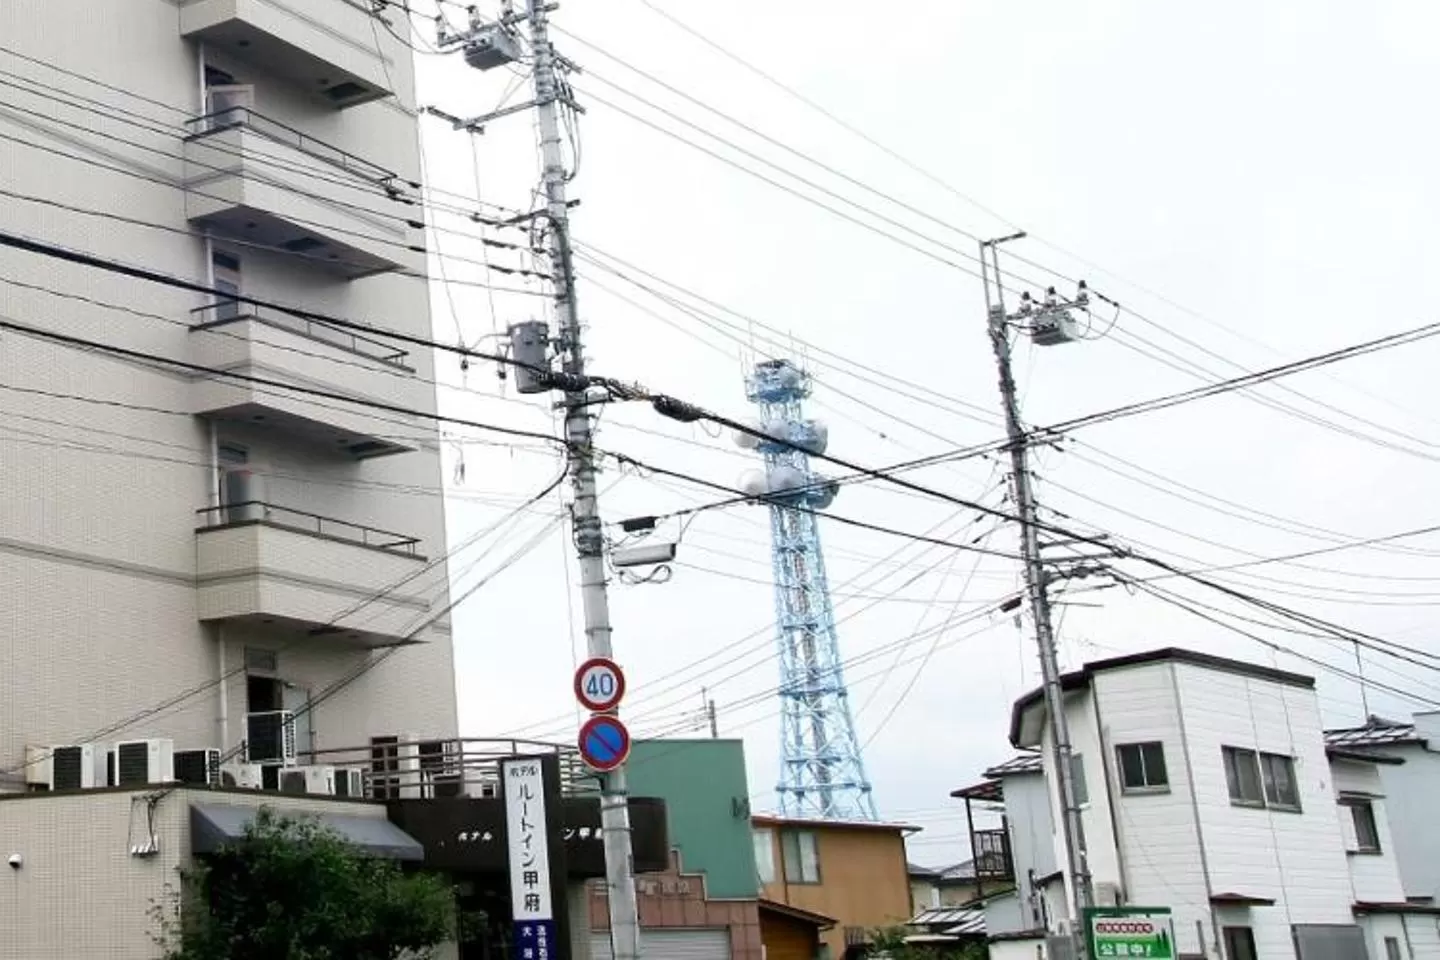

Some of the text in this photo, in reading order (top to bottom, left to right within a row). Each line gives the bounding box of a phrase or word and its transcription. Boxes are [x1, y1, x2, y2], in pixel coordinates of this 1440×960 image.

[587, 673, 613, 696] 40
[510, 765, 538, 777] ホテル
[518, 783, 541, 912] ルートイン甲府
